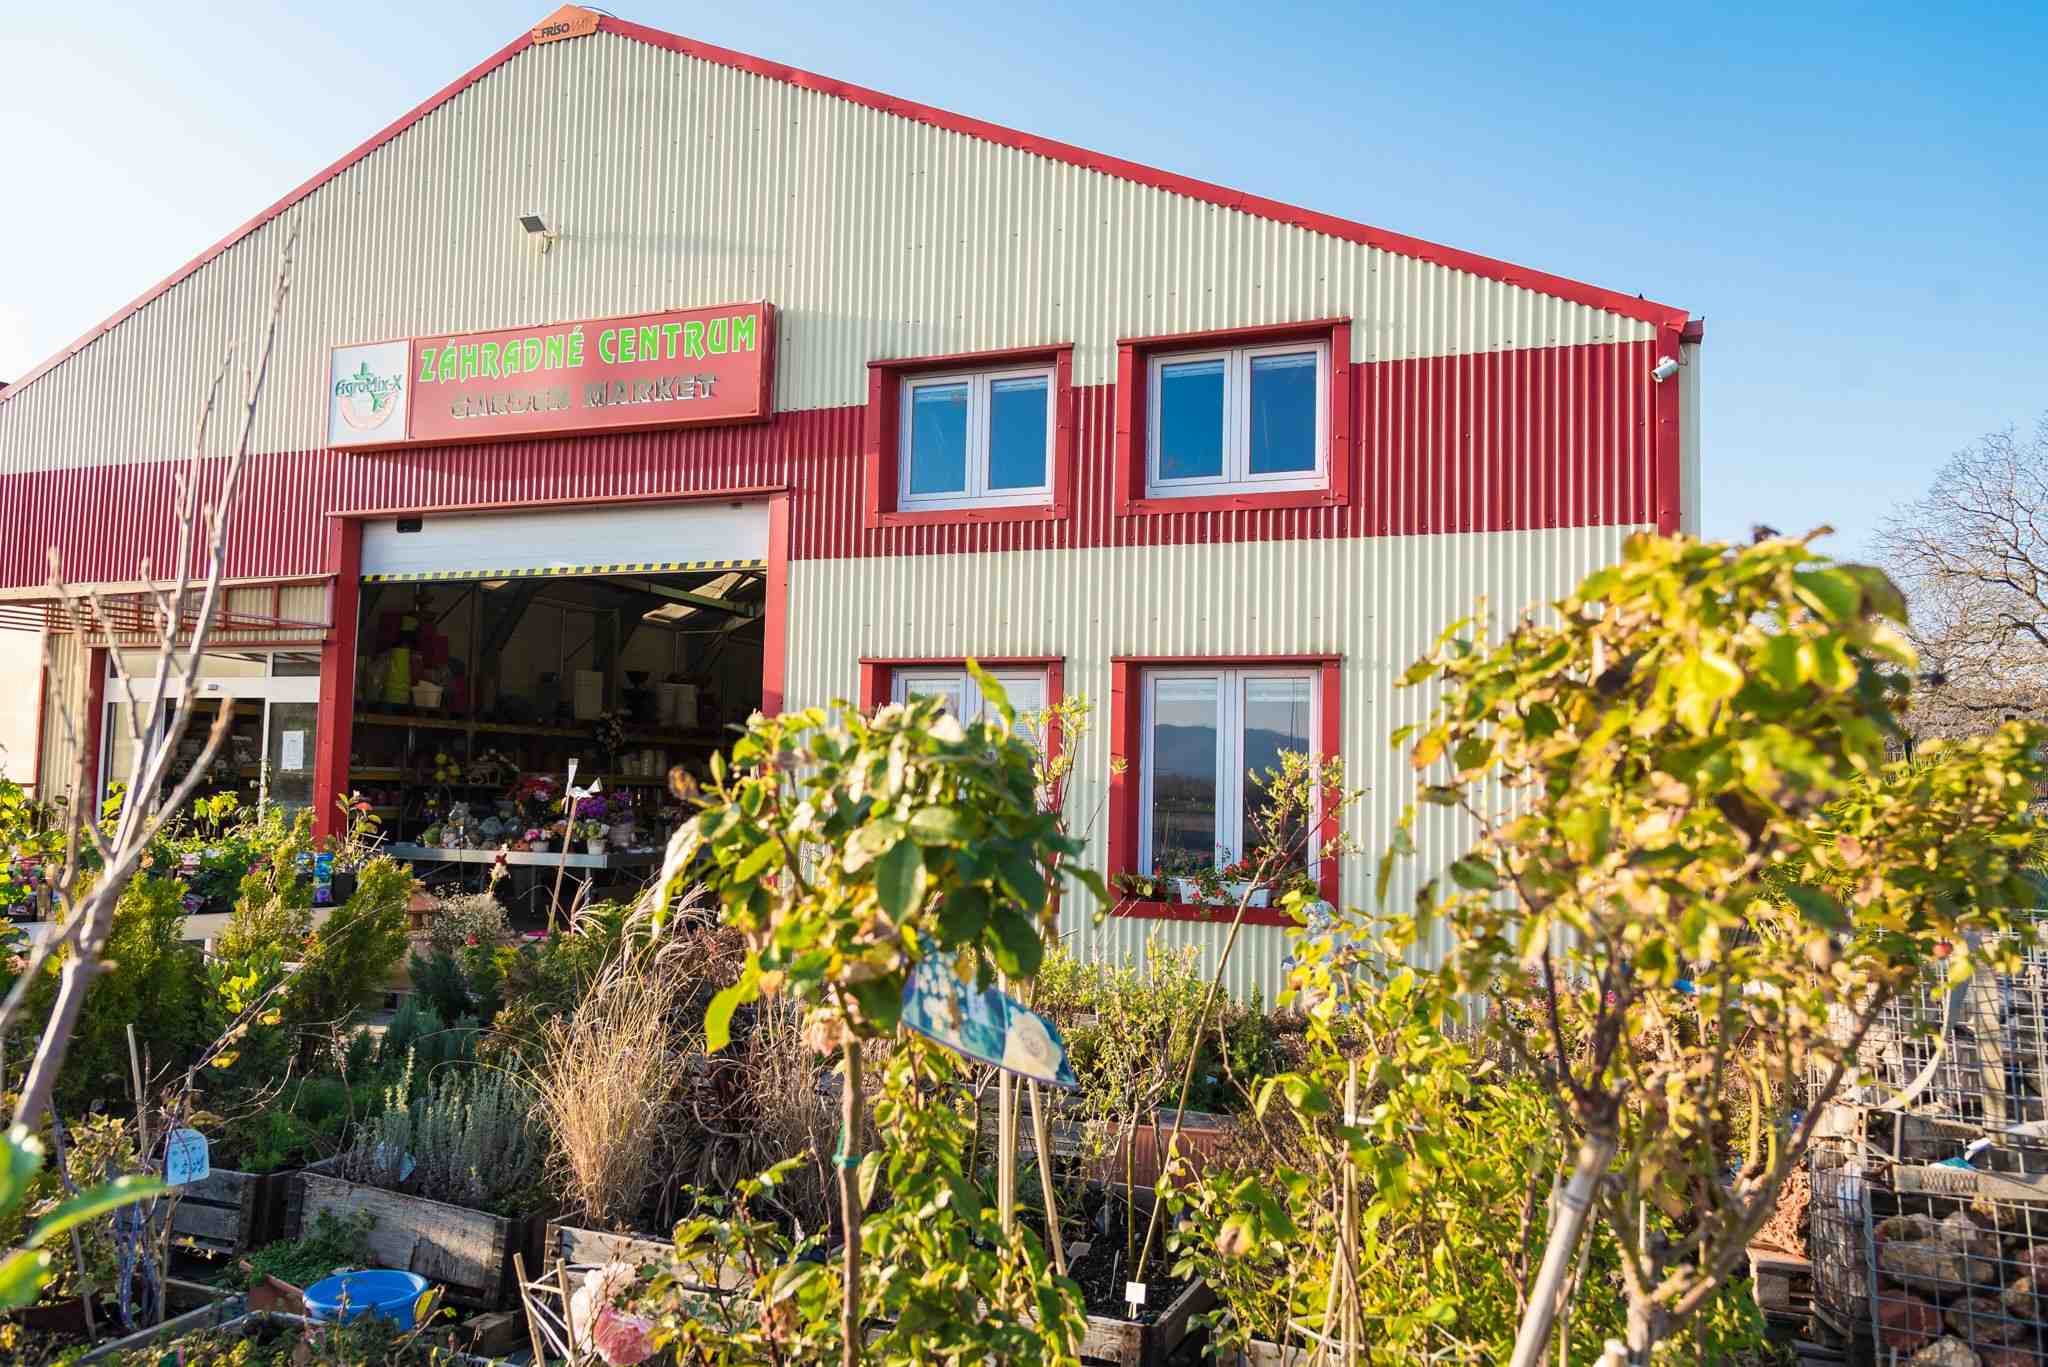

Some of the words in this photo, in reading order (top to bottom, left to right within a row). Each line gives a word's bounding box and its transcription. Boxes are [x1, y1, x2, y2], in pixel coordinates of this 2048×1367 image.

[419, 325, 585, 384] ZÁHRADNÉ
[599, 315, 757, 365] CENTRUM
[583, 374, 718, 408] MARKET
